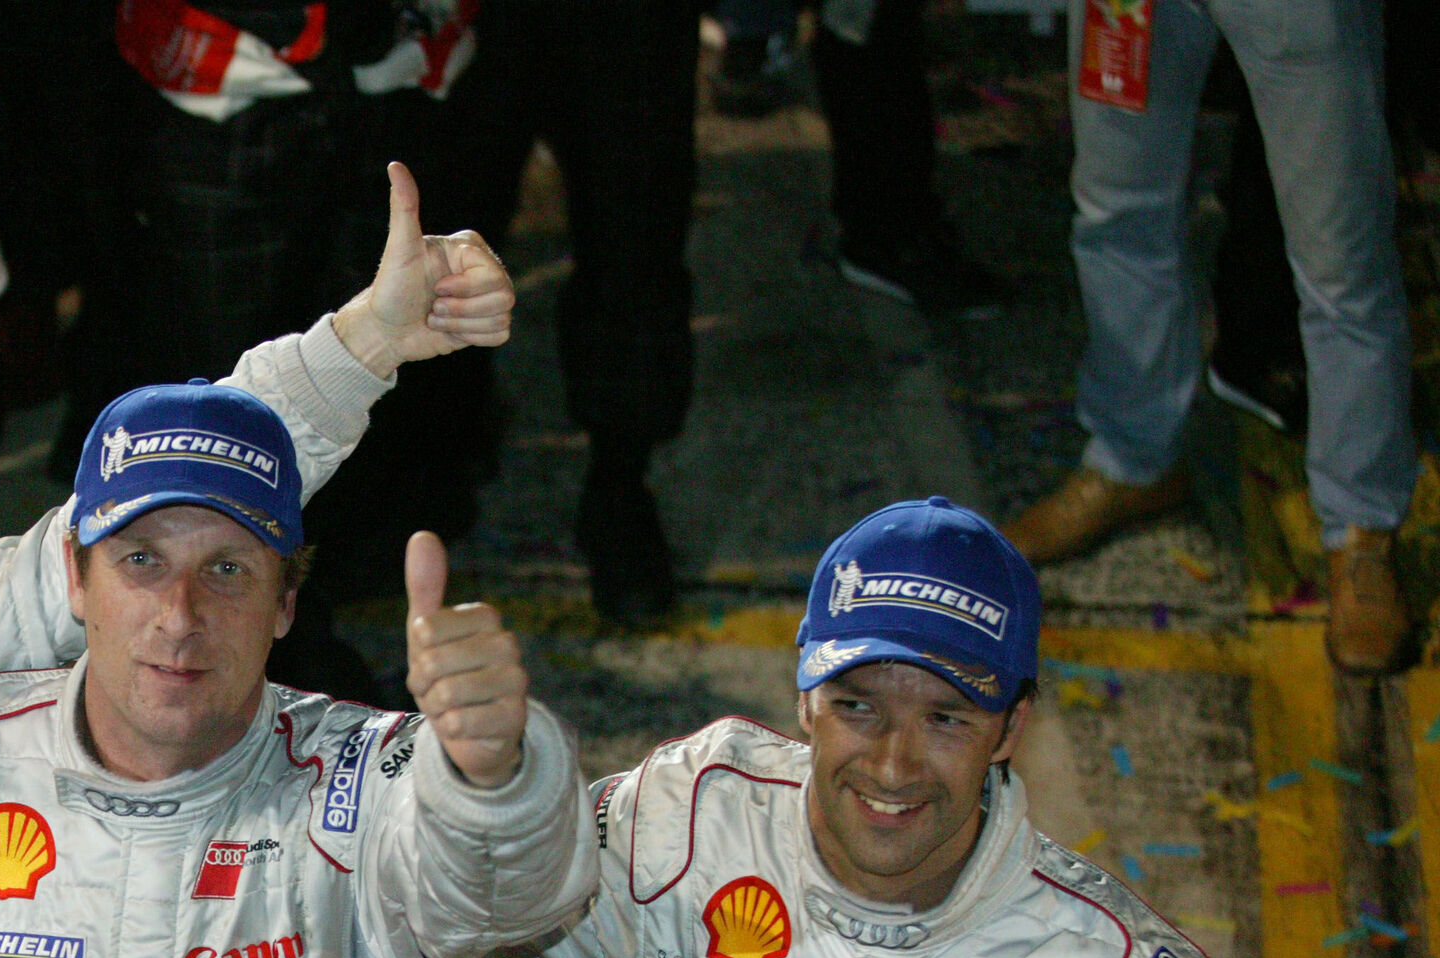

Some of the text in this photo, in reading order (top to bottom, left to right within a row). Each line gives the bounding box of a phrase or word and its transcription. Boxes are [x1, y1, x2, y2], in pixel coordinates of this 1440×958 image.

[131, 434, 275, 474] MICHELIN
[860, 578, 1003, 626] MICHELIN
[327, 730, 373, 831] sparco
[246, 840, 263, 853] udi
